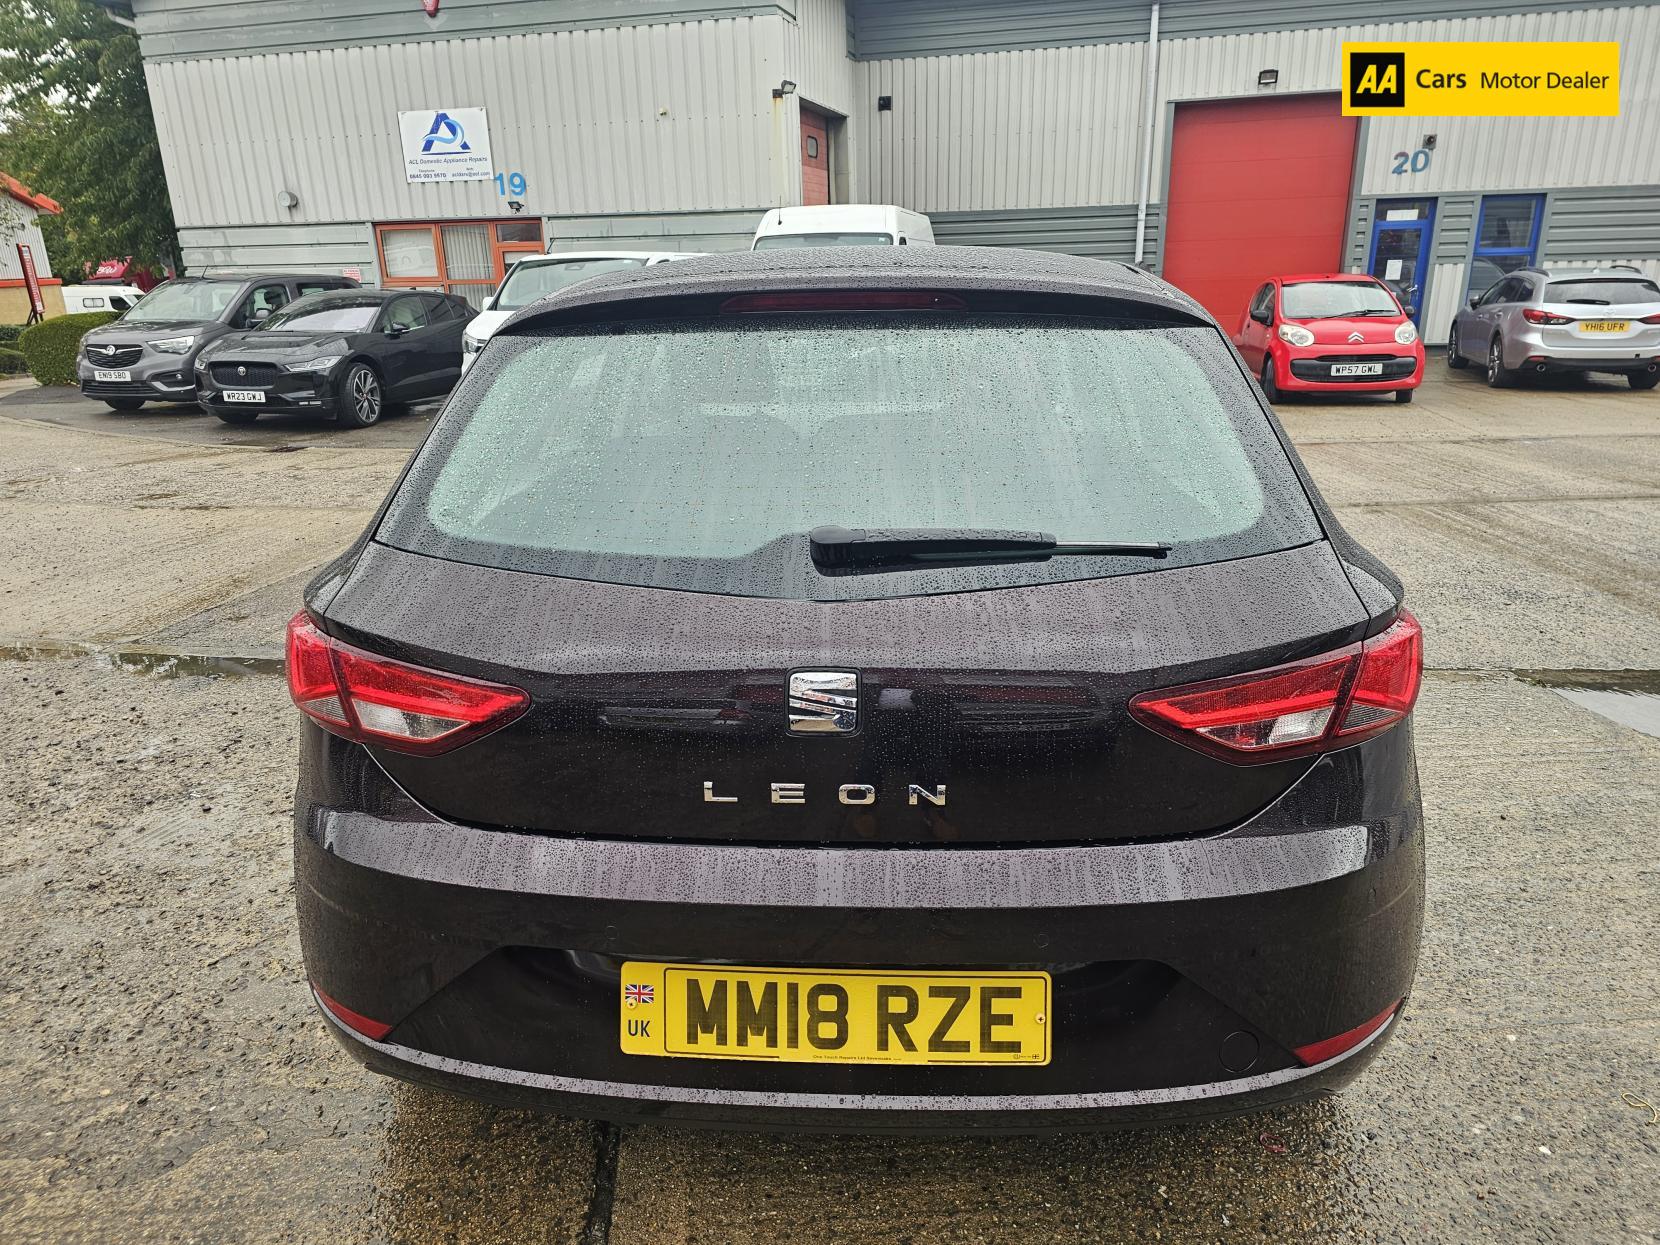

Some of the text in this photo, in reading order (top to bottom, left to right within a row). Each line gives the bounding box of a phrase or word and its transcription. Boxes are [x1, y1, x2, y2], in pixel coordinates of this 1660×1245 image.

[1391, 149, 1430, 175] 20
[494, 172, 527, 196] 19
[1584, 322, 1625, 331] YH16 UFR
[98, 371, 112, 379] EN19
[1335, 364, 1378, 374] WP57 GWL
[226, 392, 262, 401] WR23 GWJ
[703, 781, 947, 806] LEON
[686, 978, 1023, 1054] MM18 RZE
[627, 1019, 651, 1038] UK
